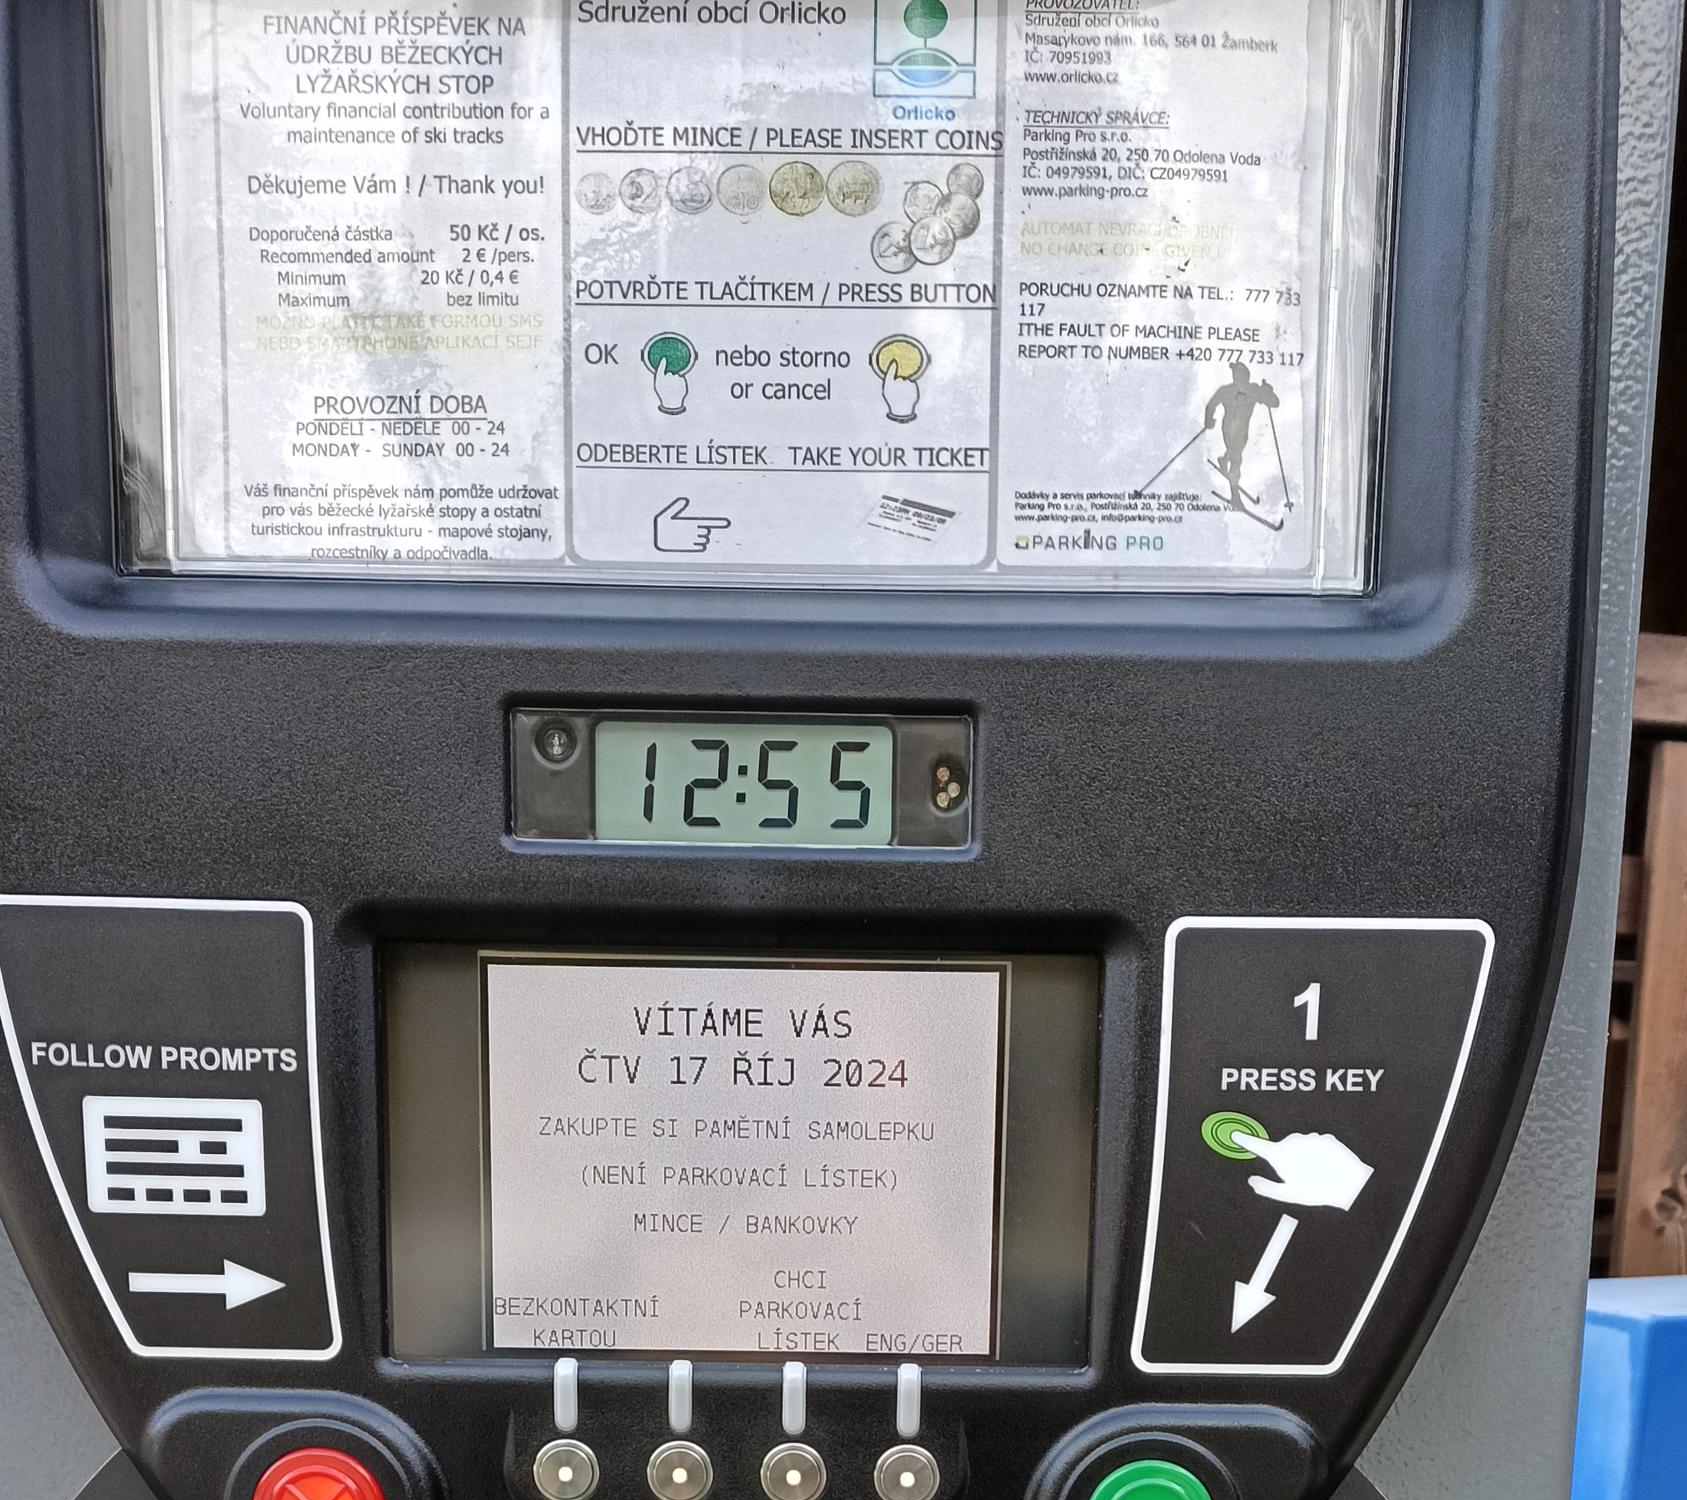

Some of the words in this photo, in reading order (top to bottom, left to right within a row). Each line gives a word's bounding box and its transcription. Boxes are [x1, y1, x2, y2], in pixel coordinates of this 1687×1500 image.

[264, 9, 366, 35] FINANČNÍ
[375, 10, 490, 36] PŘÍSPĚVEK
[498, 17, 526, 36] NA
[578, 0, 689, 23] Sdružení
[698, 0, 750, 23] obcí
[759, 1, 846, 24] Orlicko
[286, 38, 371, 64] ÚDRŽBU
[381, 39, 502, 65] BĚŽECKÝCH
[1025, 46, 1043, 64] IČ:
[1049, 50, 1112, 65] 70951993
[296, 68, 430, 94] LYŽAŘSKÝCH
[439, 75, 494, 94] STOP
[1024, 70, 1118, 84] www.orlicko.cz
[240, 102, 320, 122] Voluntary
[327, 102, 396, 119] financial
[403, 103, 504, 119] contribution
[511, 102, 534, 119] for
[540, 107, 549, 119] a
[892, 105, 956, 121] Orlicko
[1023, 107, 1102, 126] TECHNICKÝ
[1105, 106, 1170, 126] SPRÁVCE:
[287, 128, 395, 144] maintenance
[401, 127, 419, 143] of
[425, 127, 446, 143] ski
[453, 127, 503, 144] tracks
[576, 120, 664, 146] VHOĎTE
[673, 127, 742, 147] MINCE
[767, 128, 842, 148] PLEASE
[851, 129, 928, 149] INSERT
[936, 130, 1004, 151] COINS
[1024, 128, 1070, 145] Parking
[1075, 129, 1096, 142] Pro
[1100, 131, 1132, 143] s.r.o.
[1023, 147, 1097, 161] Postřižínská
[1101, 148, 1120, 163] 20,
[1126, 148, 1149, 163] 250
[1154, 149, 1169, 162] 70
[1173, 149, 1225, 164] Odolena
[1230, 152, 1261, 166] Voda
[248, 174, 346, 199] Děkujeme
[353, 173, 396, 194] Vám
[433, 175, 495, 194] Thank
[502, 176, 543, 198] you!
[1022, 183, 1148, 200] www.parking-pro.cz
[249, 225, 339, 244] Doporučená
[345, 225, 392, 241] částka
[450, 224, 471, 241] 50
[478, 223, 499, 241] Kč
[519, 228, 544, 241] os.
[278, 293, 350, 308] Maximum
[447, 292, 472, 307] bez
[478, 291, 519, 306] limitu
[576, 274, 688, 300] POTVRĎTE
[695, 275, 813, 301] TLAČÍTKEM
[839, 283, 902, 303] PRESS
[911, 283, 997, 303] BUTTON
[585, 343, 618, 364] OK
[716, 345, 770, 367] nebo
[780, 347, 850, 368] storno
[1018, 344, 1077, 359] REPORT
[1081, 345, 1102, 359] TO
[1107, 346, 1169, 363] NUMBER
[1176, 347, 1211, 361] +420
[1218, 348, 1243, 364] 777
[1249, 350, 1274, 364] 733
[1280, 352, 1304, 366] 117
[731, 383, 753, 399] or
[762, 378, 830, 400] cancel
[314, 389, 421, 414] PROVOZNÍ
[430, 395, 487, 414] DOBA
[577, 443, 687, 464] ODEBERTE
[696, 439, 767, 465] LÍSTEK
[788, 447, 841, 465] TAKE
[849, 447, 907, 466] YOUR
[913, 447, 990, 467] TICKET
[244, 483, 269, 497] Váš
[273, 483, 328, 497] finanční
[334, 484, 399, 503] příspěvek
[405, 484, 434, 499] nám
[440, 484, 493, 501] pomůže
[499, 485, 559, 499] udržovat
[1033, 528, 1116, 551] PARKING
[1126, 536, 1163, 551] PRO
[644, 740, 870, 829] 12:55
[634, 1001, 763, 1037] VÍTÁME
[790, 1003, 852, 1038] VÁS
[1294, 983, 1320, 1040] 1
[32, 1042, 152, 1068] FOLLOW
[161, 1046, 297, 1071] PROMPTS
[579, 1048, 641, 1083] ČTV
[671, 1056, 707, 1084] 17
[734, 1051, 794, 1086] ŘÍJ
[824, 1059, 908, 1087] 2024
[1222, 1068, 1316, 1091] PRESS
[1326, 1069, 1384, 1091] KEY
[539, 1117, 636, 1137] ZAKUPTE
[653, 1119, 677, 1137] SI
[695, 1115, 790, 1139] PAMĚTNÍ
[809, 1121, 933, 1141] SAMOLEPKU
[583, 1162, 646, 1186] (NENÍ
[664, 1164, 787, 1187] PARKOVACÍ
[805, 1164, 896, 1191] LÍSTEK)
[634, 1214, 702, 1232] MINCE
[747, 1215, 858, 1234] BANKOVKY
[774, 1270, 826, 1289] CHCI
[495, 1295, 658, 1317] BEZKONTAKTNÍ
[740, 1298, 861, 1320] PARKOVACÍ
[534, 1328, 615, 1347] KARTOU
[758, 1328, 839, 1350] LÍSTEK
[866, 1334, 963, 1352] ENG/GER
